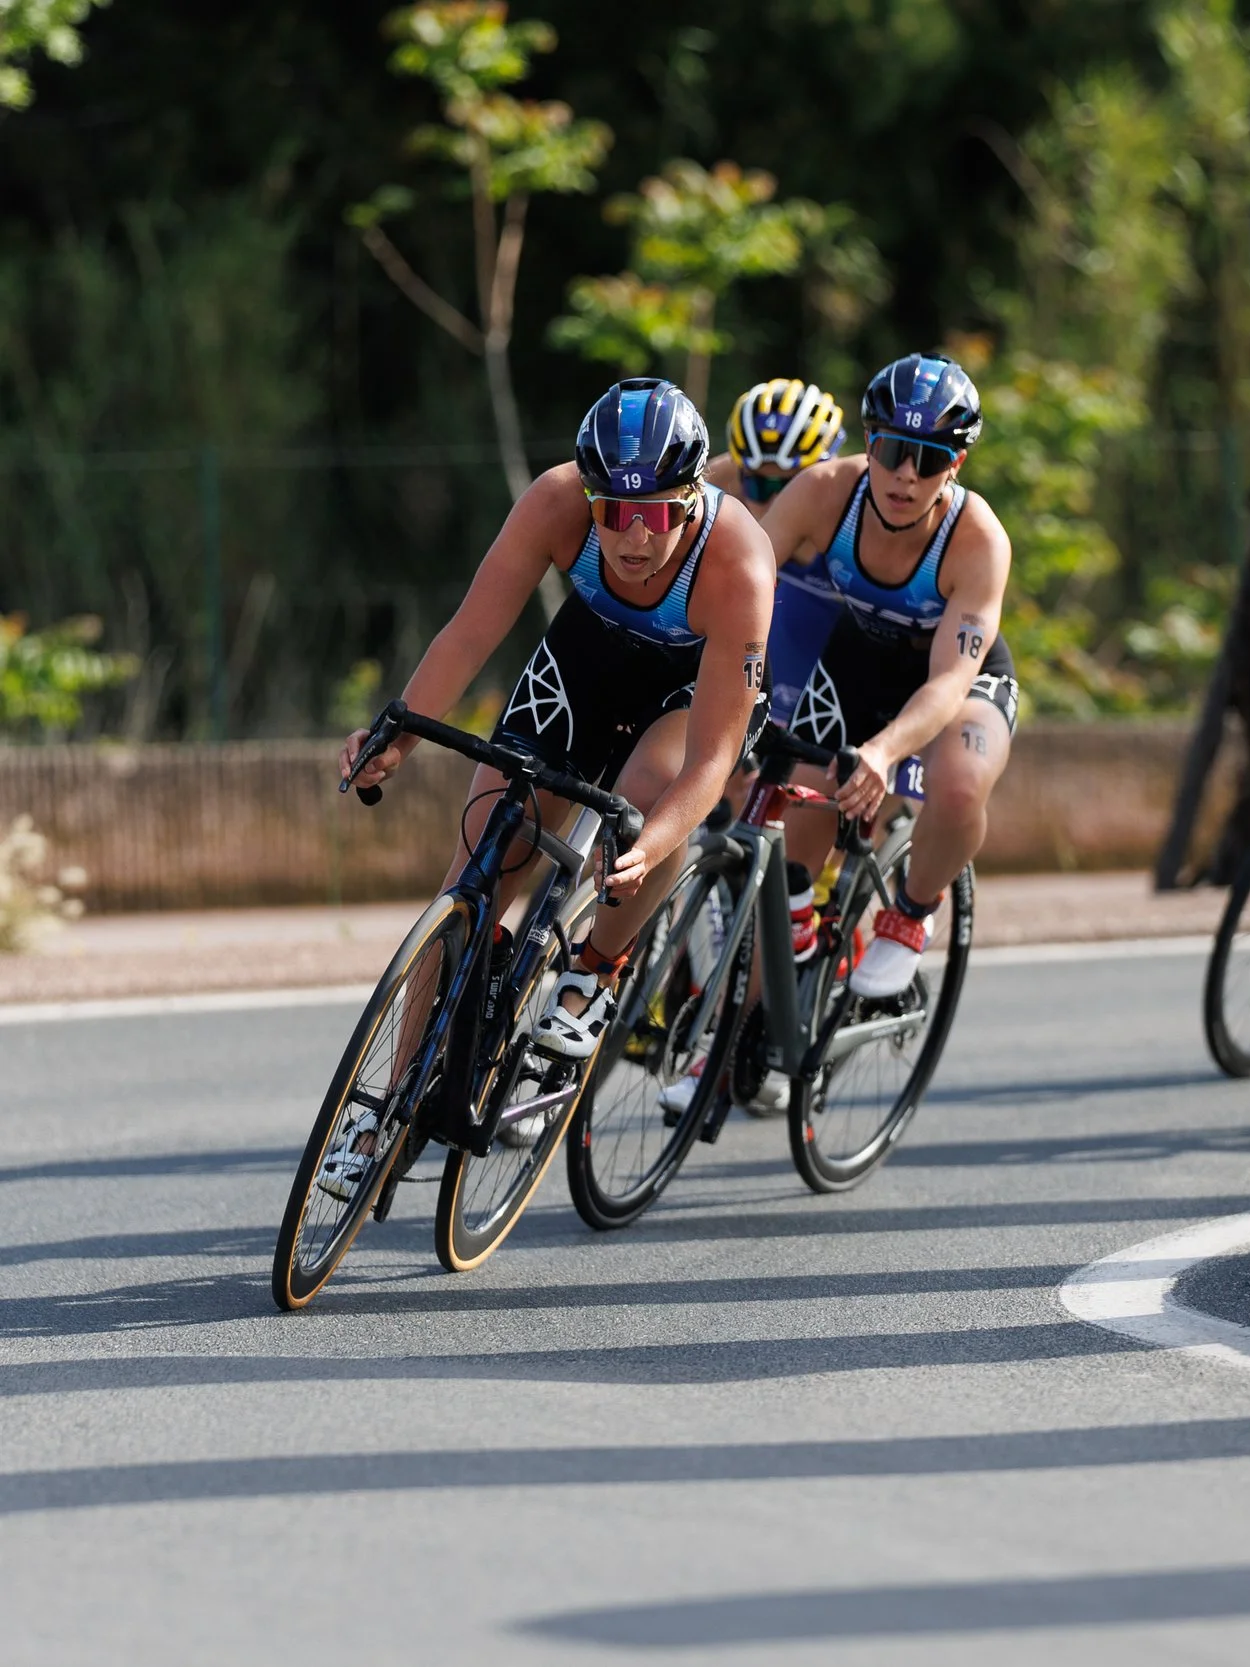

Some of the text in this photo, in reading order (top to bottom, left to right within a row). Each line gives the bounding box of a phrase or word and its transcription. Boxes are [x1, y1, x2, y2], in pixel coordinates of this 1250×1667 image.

[765, 413, 777, 429] 4
[904, 410, 923, 429] 18
[621, 472, 642, 490] 19
[956, 631, 984, 660] 18
[743, 661, 764, 689] 19
[961, 732, 988, 756] 18
